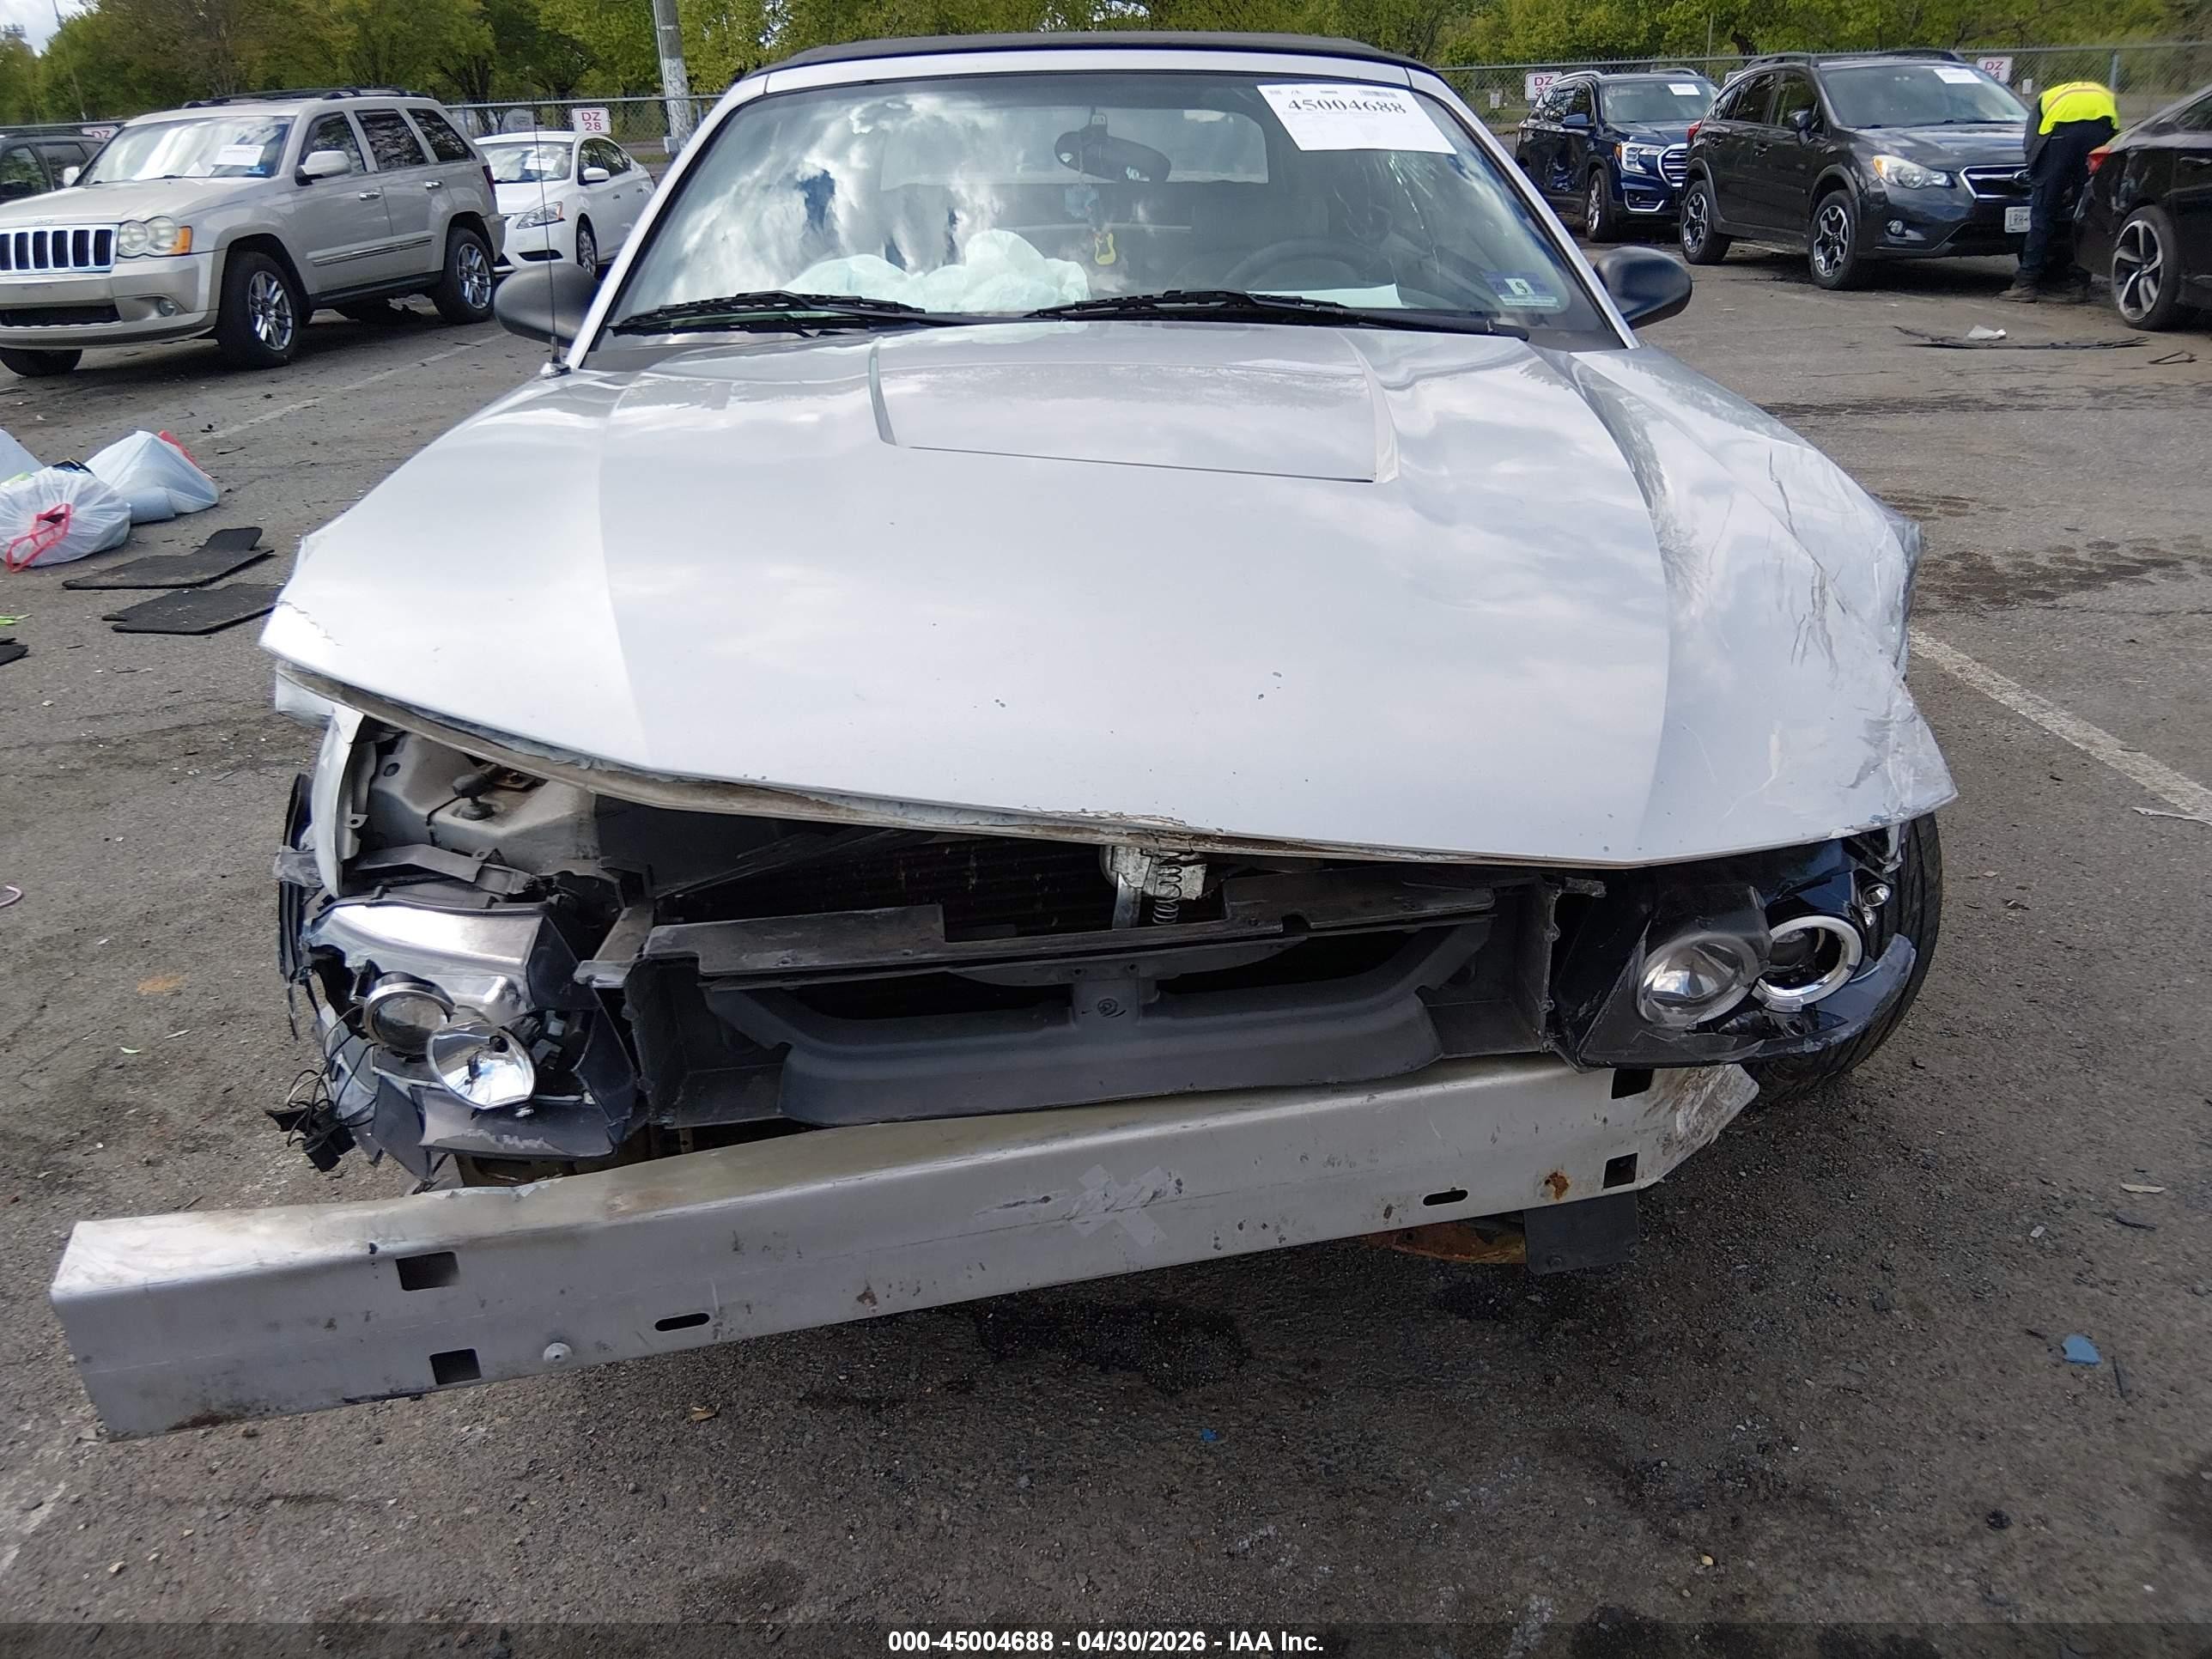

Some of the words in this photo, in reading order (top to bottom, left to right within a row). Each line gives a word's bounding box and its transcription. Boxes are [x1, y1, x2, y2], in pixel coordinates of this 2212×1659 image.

[1984, 61, 2003, 70] DZ
[1534, 76, 1553, 87] DZ
[1288, 99, 1407, 113] 45004688
[581, 112, 602, 121] DZ
[585, 122, 602, 131] 28
[1515, 281, 1528, 294] 9
